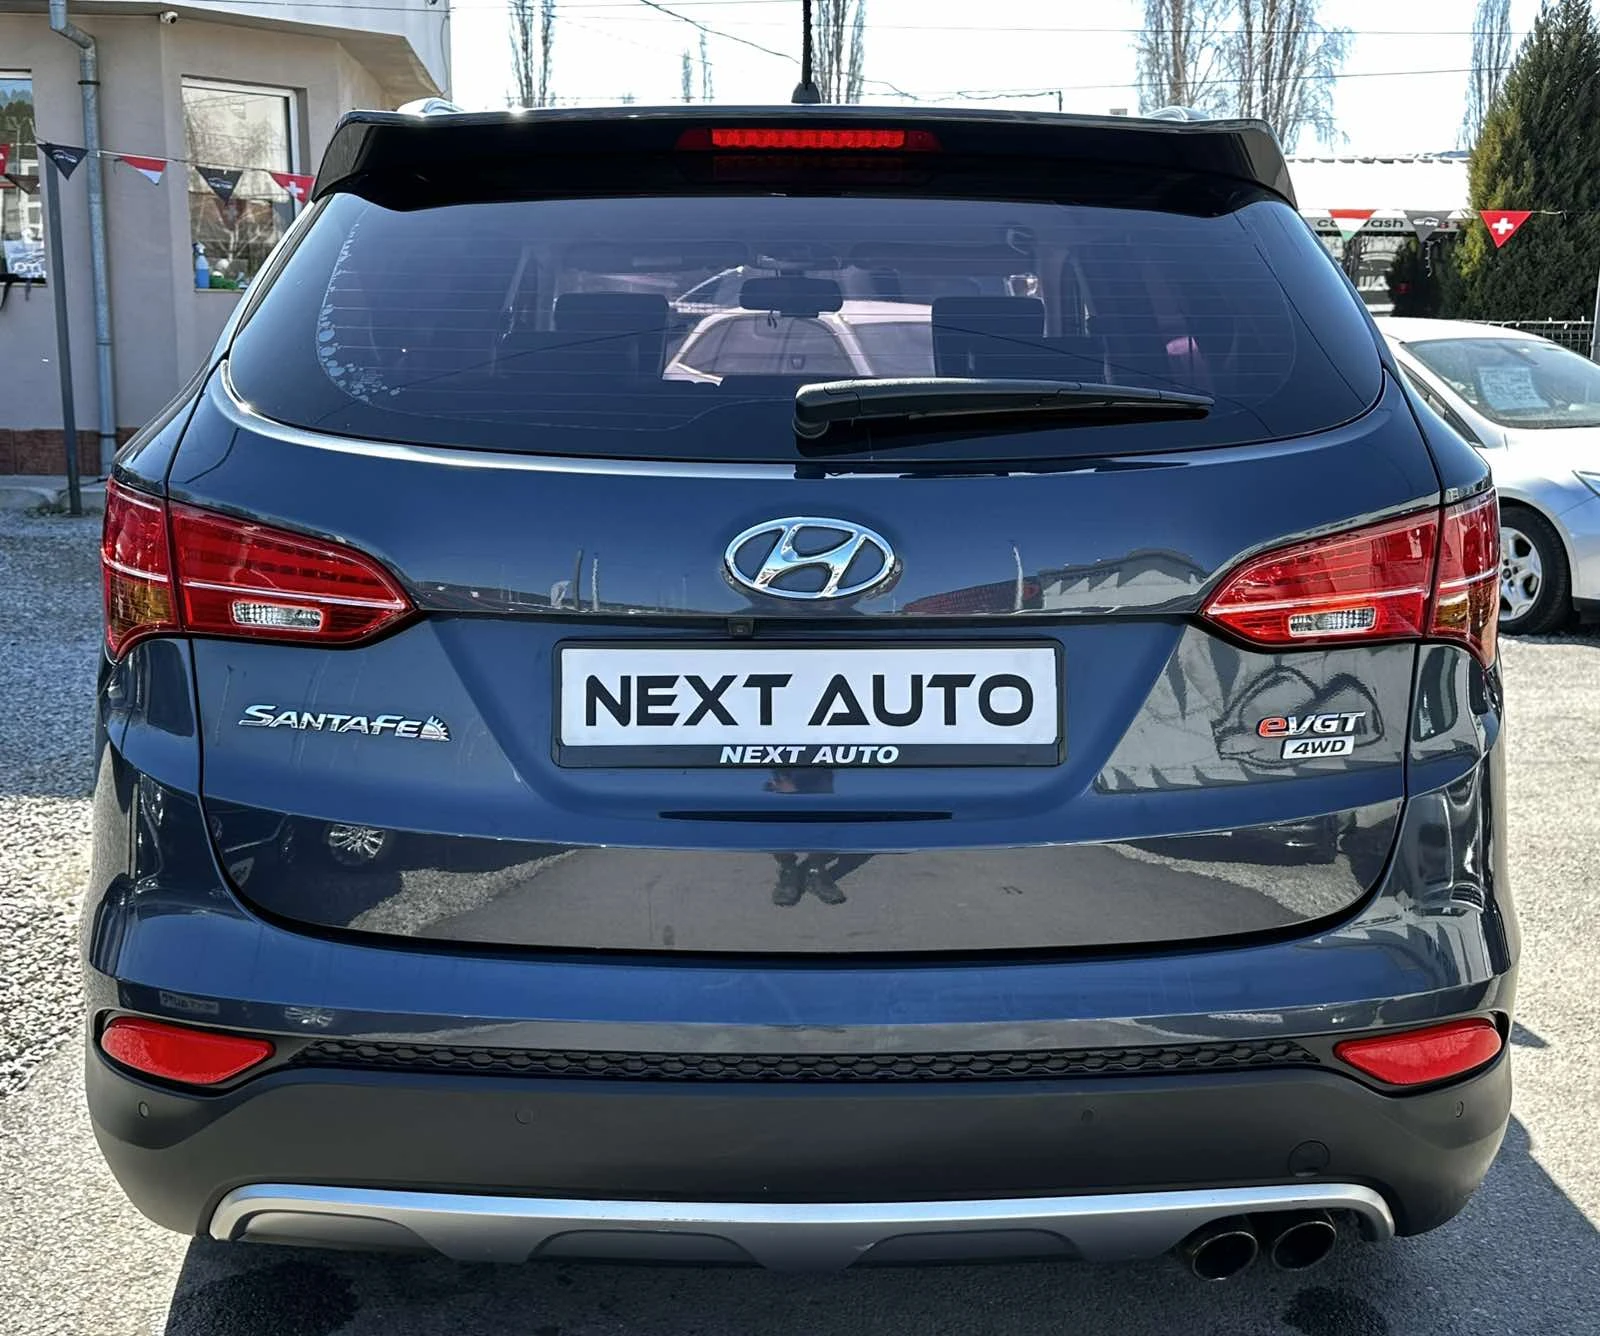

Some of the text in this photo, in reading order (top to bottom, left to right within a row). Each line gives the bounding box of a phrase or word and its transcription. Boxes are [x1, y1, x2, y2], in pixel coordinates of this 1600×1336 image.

[586, 673, 1034, 727] NEXT AUTO
[719, 745, 900, 764] NEXT AUTO
[1292, 739, 1346, 755] 4WD
